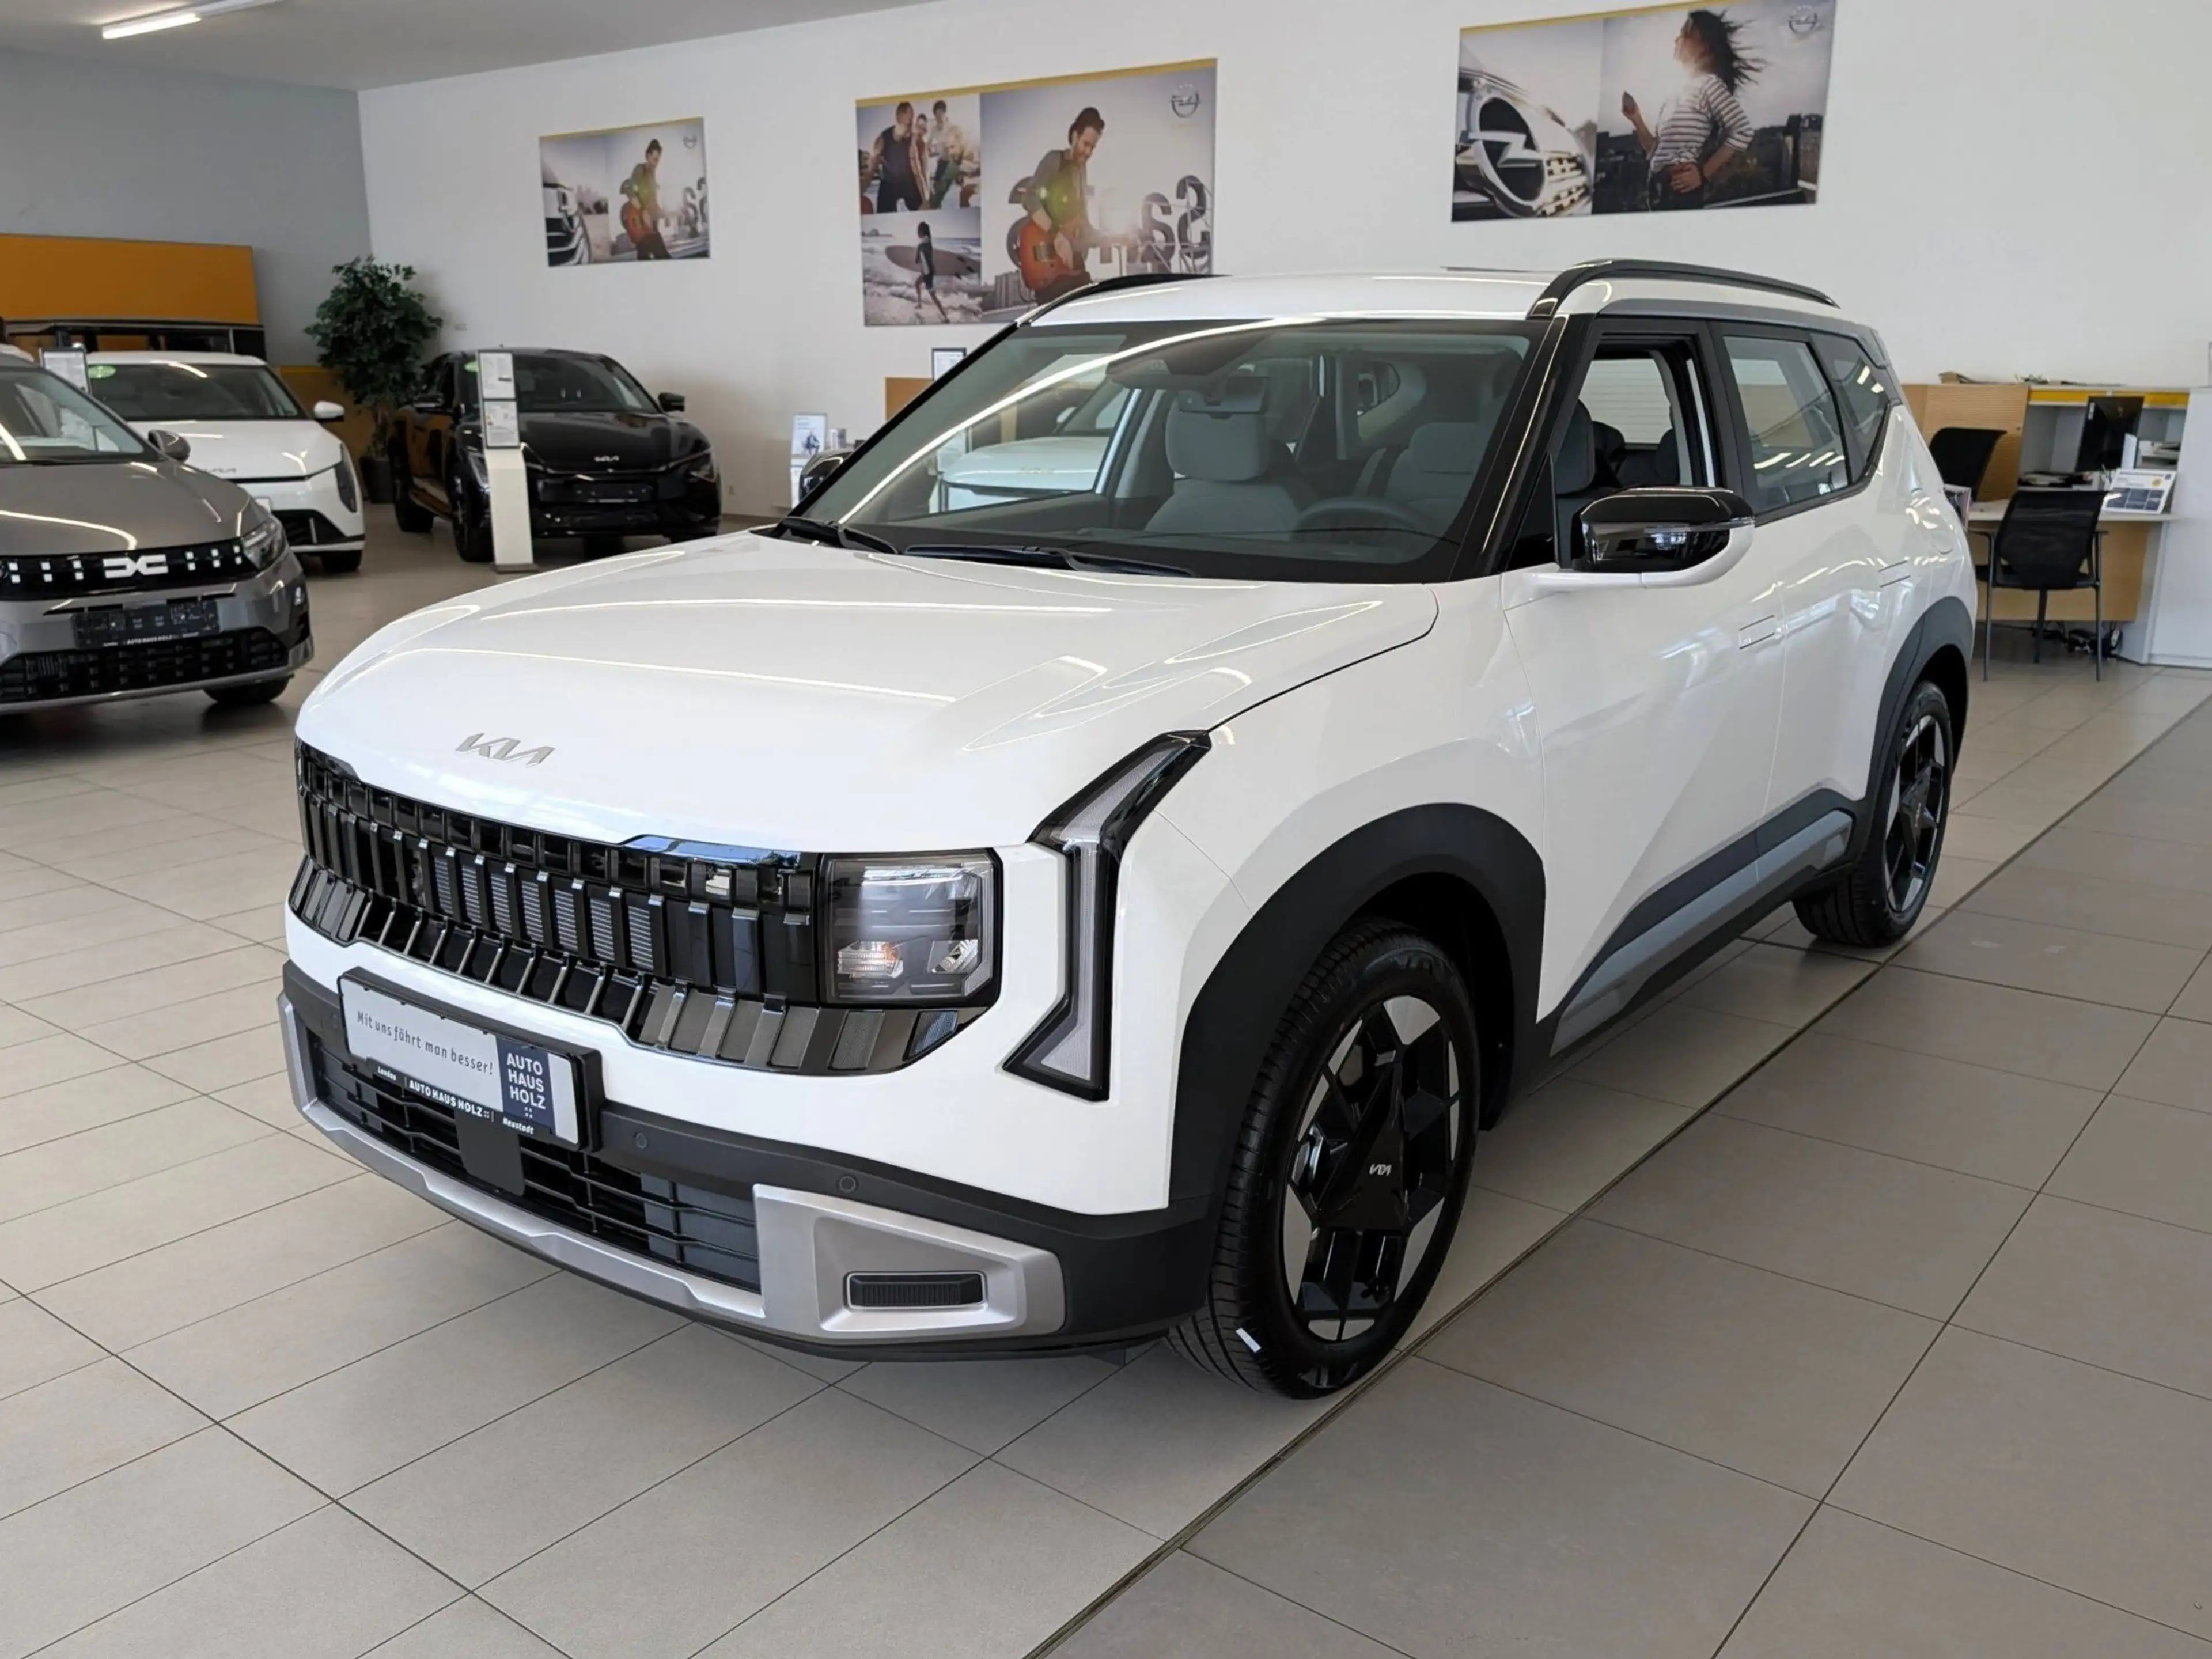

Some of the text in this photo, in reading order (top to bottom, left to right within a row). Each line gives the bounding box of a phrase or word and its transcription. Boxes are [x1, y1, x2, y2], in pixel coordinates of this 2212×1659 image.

[454, 732, 556, 766] KIA
[357, 1010, 493, 1075] Mit uns fährt man besser!
[506, 1052, 543, 1076] AUTO
[507, 1068, 544, 1093] HAUS
[509, 1085, 546, 1110] HOLZ
